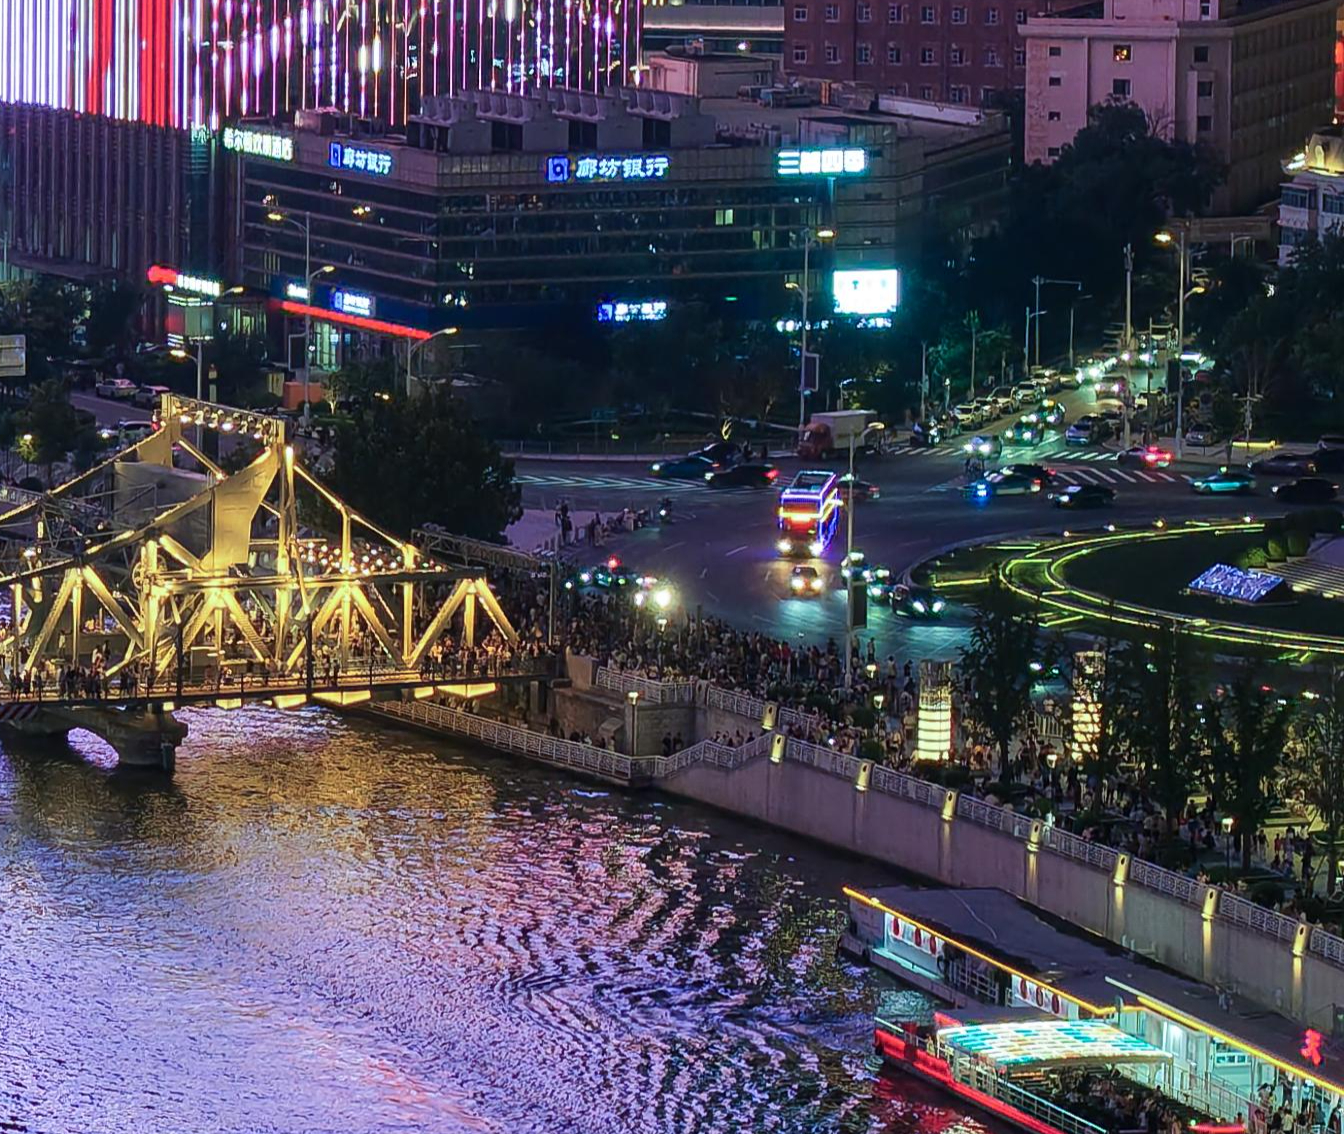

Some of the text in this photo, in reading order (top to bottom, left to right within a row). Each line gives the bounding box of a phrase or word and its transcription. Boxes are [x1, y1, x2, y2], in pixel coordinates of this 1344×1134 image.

[342, 147, 392, 175] 廊坊银行
[576, 157, 668, 178] 廊坊银行
